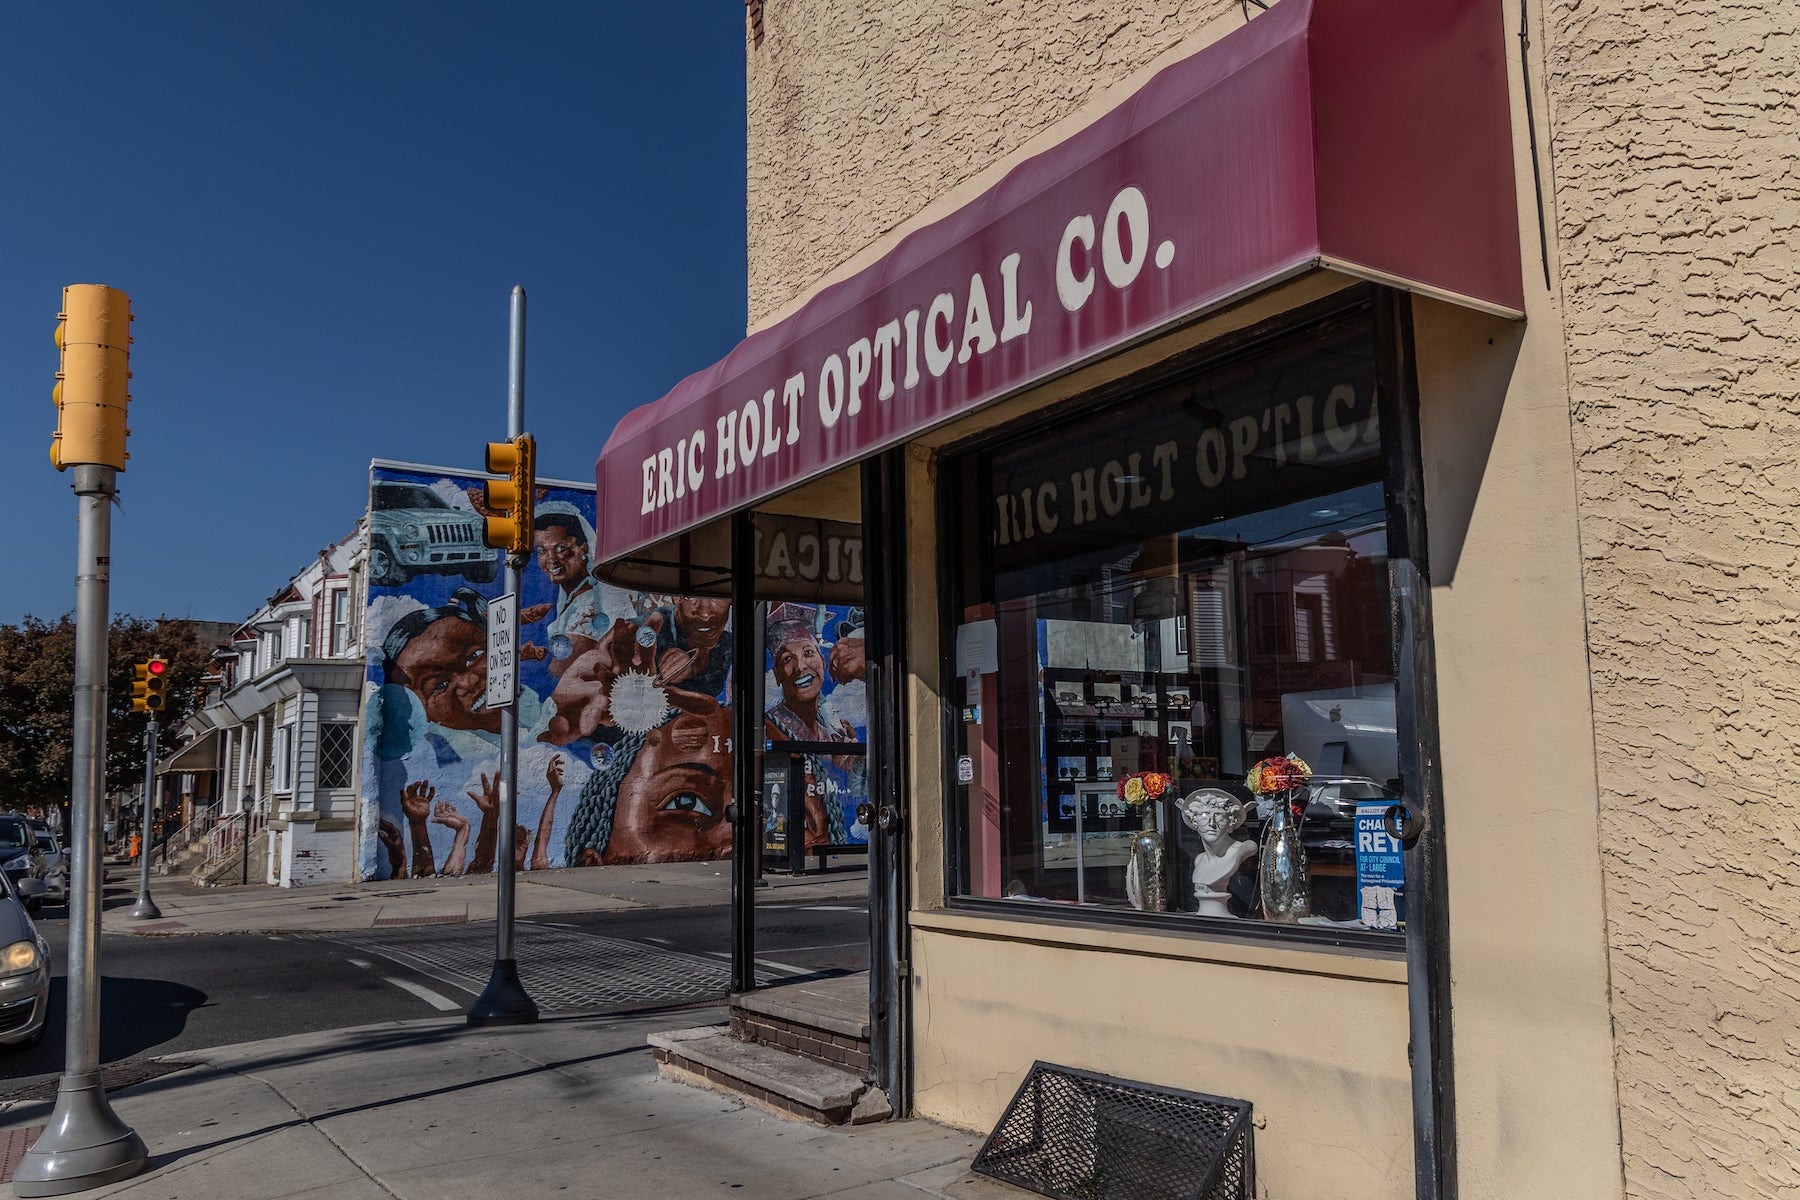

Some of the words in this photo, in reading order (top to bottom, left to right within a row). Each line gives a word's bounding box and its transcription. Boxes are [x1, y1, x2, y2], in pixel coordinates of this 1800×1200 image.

[640, 429, 705, 516] ERIC
[715, 372, 805, 480] HOLT
[818, 252, 1032, 428] OPTICAL
[1056, 187, 1176, 312] CO.
[993, 480, 1059, 547] RIC
[1071, 440, 1179, 526] HOLT
[495, 608, 506, 626] NO
[492, 628, 511, 649] TURN
[489, 655, 499, 671] ON
[500, 650, 512, 668] RED
[1360, 855, 1368, 863] FOR
[1369, 855, 1379, 863] CITY
[1379, 856, 1401, 864] COUNCIL
[1369, 864, 1387, 872] LARGE
